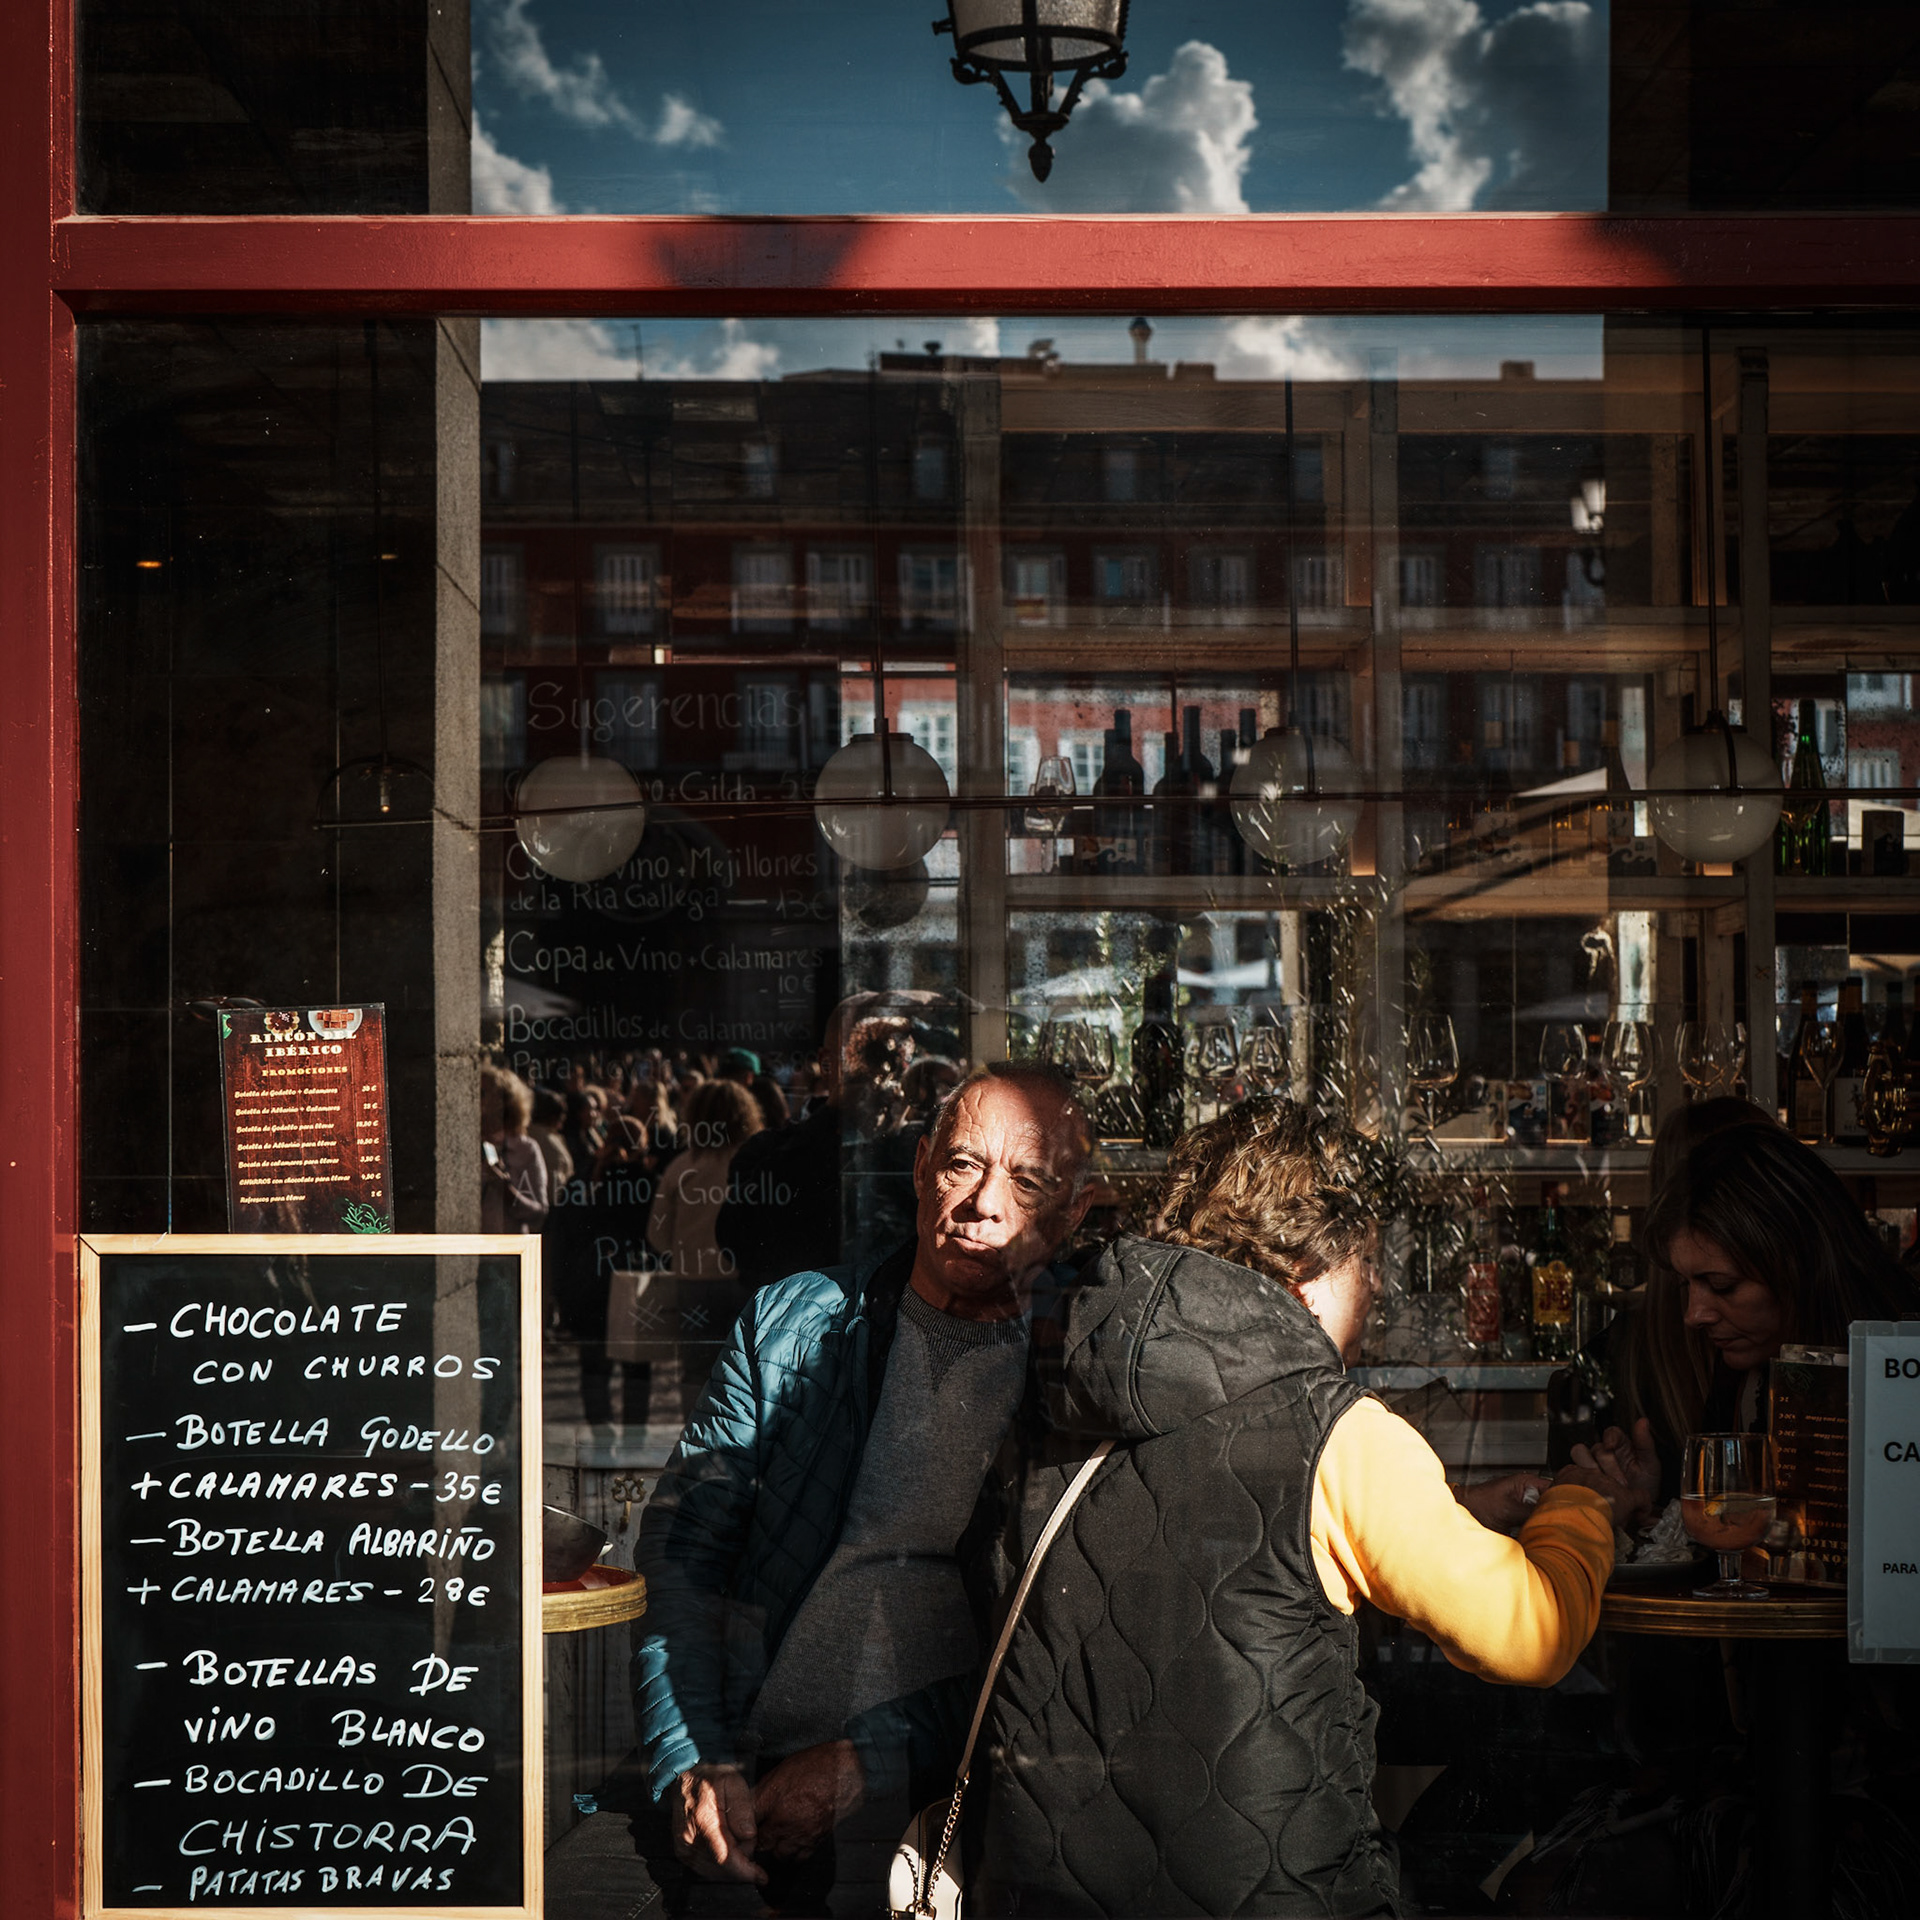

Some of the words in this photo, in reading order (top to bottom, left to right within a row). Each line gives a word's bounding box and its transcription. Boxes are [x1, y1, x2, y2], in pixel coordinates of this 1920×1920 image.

[528, 682, 803, 743] Sugerencias
[680, 772, 756, 801] Gilda
[691, 845, 818, 887] Mejillones
[510, 895, 534, 912] de
[541, 884, 561, 910] la
[625, 884, 719, 921] Gallega
[508, 931, 586, 983] Copa
[593, 955, 614, 971] de
[617, 938, 681, 971] Vino
[702, 944, 823, 971] Calamares
[250, 1029, 316, 1043] RINCÓN
[323, 1030, 356, 1040] DEL
[508, 1004, 642, 1043] Bocadillos
[649, 1020, 672, 1039] de
[679, 1010, 811, 1041] Calamares
[265, 1045, 342, 1057] IBÉRICO
[513, 1051, 571, 1081] Para
[262, 1066, 348, 1076] PROMOCIONES
[613, 1106, 726, 1151] Vinos
[284, 1176, 314, 1184] chocolate
[512, 1168, 653, 1207] Abariño
[678, 1169, 792, 1205] Godello
[596, 1236, 736, 1278] Ribeiro
[170, 1301, 408, 1339] CHOCOLATE
[192, 1358, 273, 1385] CON
[304, 1354, 501, 1380] CHURROS
[175, 1414, 329, 1450] BOTELLA
[360, 1416, 495, 1458] GODELLO
[167, 1518, 325, 1556] BOTELLA
[1883, 1562, 1918, 1575] PARA
[182, 1649, 377, 1689] BOTELLAS
[409, 1652, 480, 1697] DE
[331, 1709, 485, 1753] BLANCO
[402, 1763, 489, 1798] DE
[190, 1866, 305, 1902] PATATAS
[318, 1865, 455, 1893] BRAVAS
